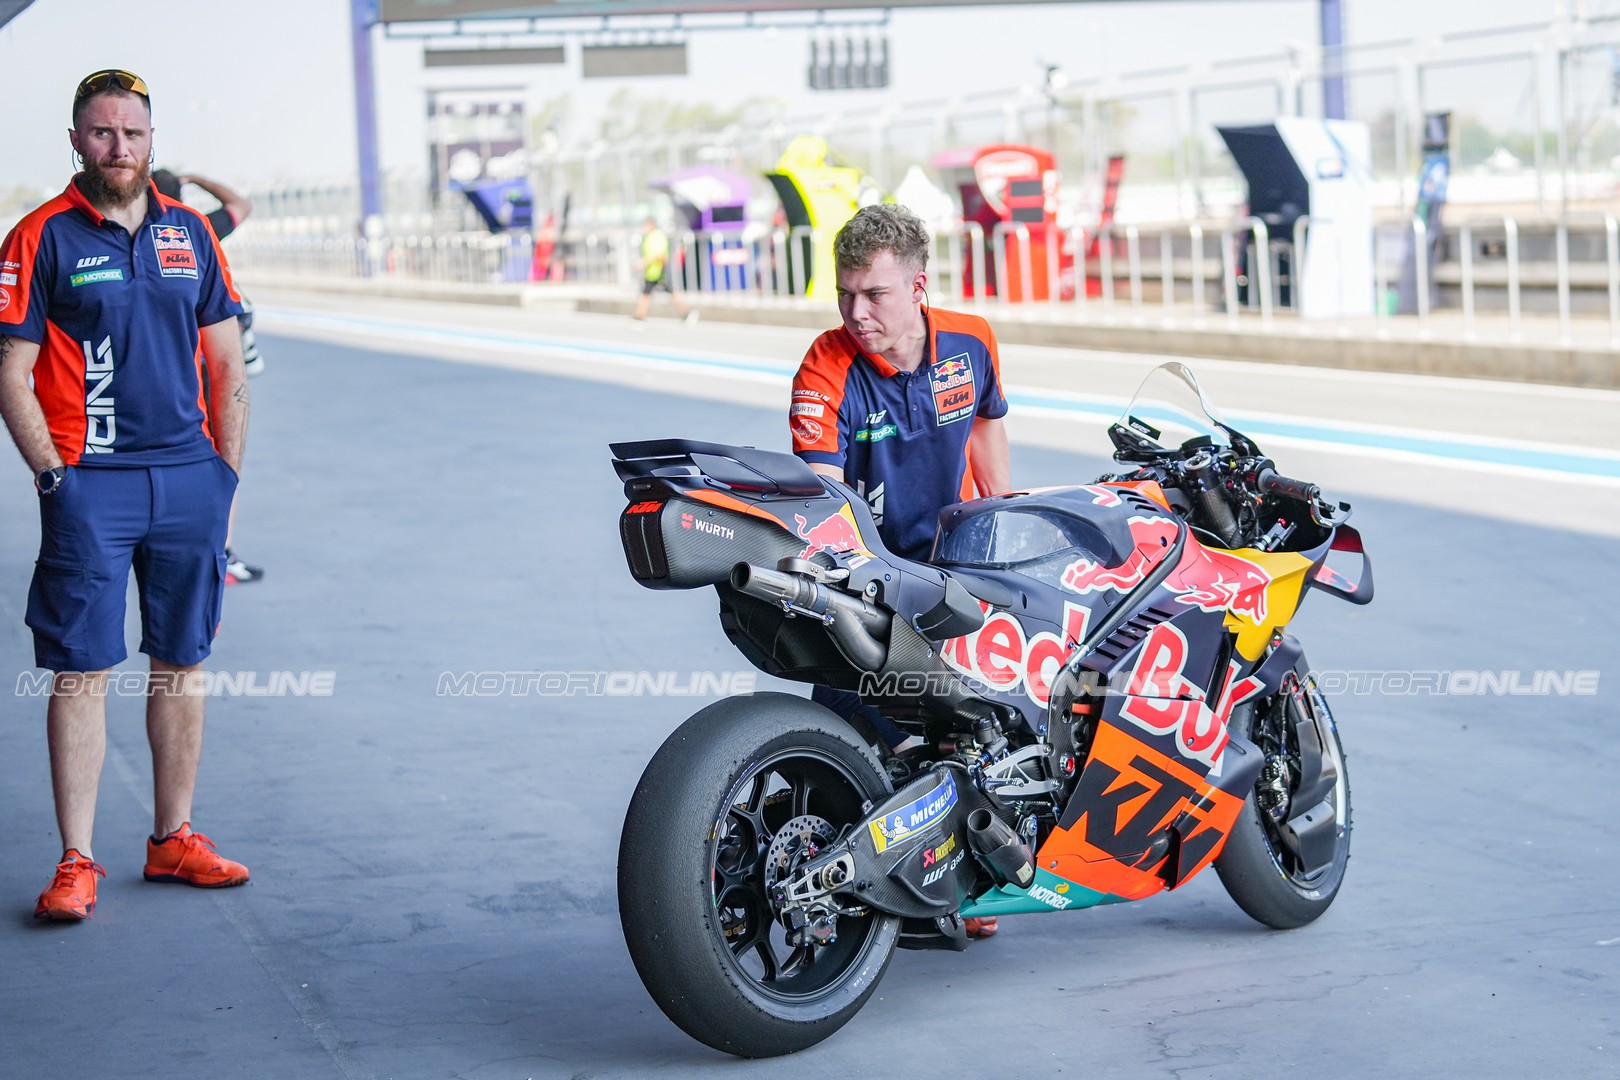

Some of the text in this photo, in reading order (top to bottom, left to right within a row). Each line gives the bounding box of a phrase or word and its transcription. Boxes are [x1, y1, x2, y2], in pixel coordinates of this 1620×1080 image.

[76, 256, 110, 269] WP
[165, 254, 190, 263] KTM
[84, 271, 121, 281] MOTOREX
[943, 391, 969, 407] KTM
[870, 426, 894, 440] OTOREX
[626, 501, 663, 514] KTM
[910, 785, 953, 827] MICHELIN
[1058, 755, 1224, 885] KTM
[922, 862, 948, 887] WP
[1027, 883, 1073, 910] MOTOREX
